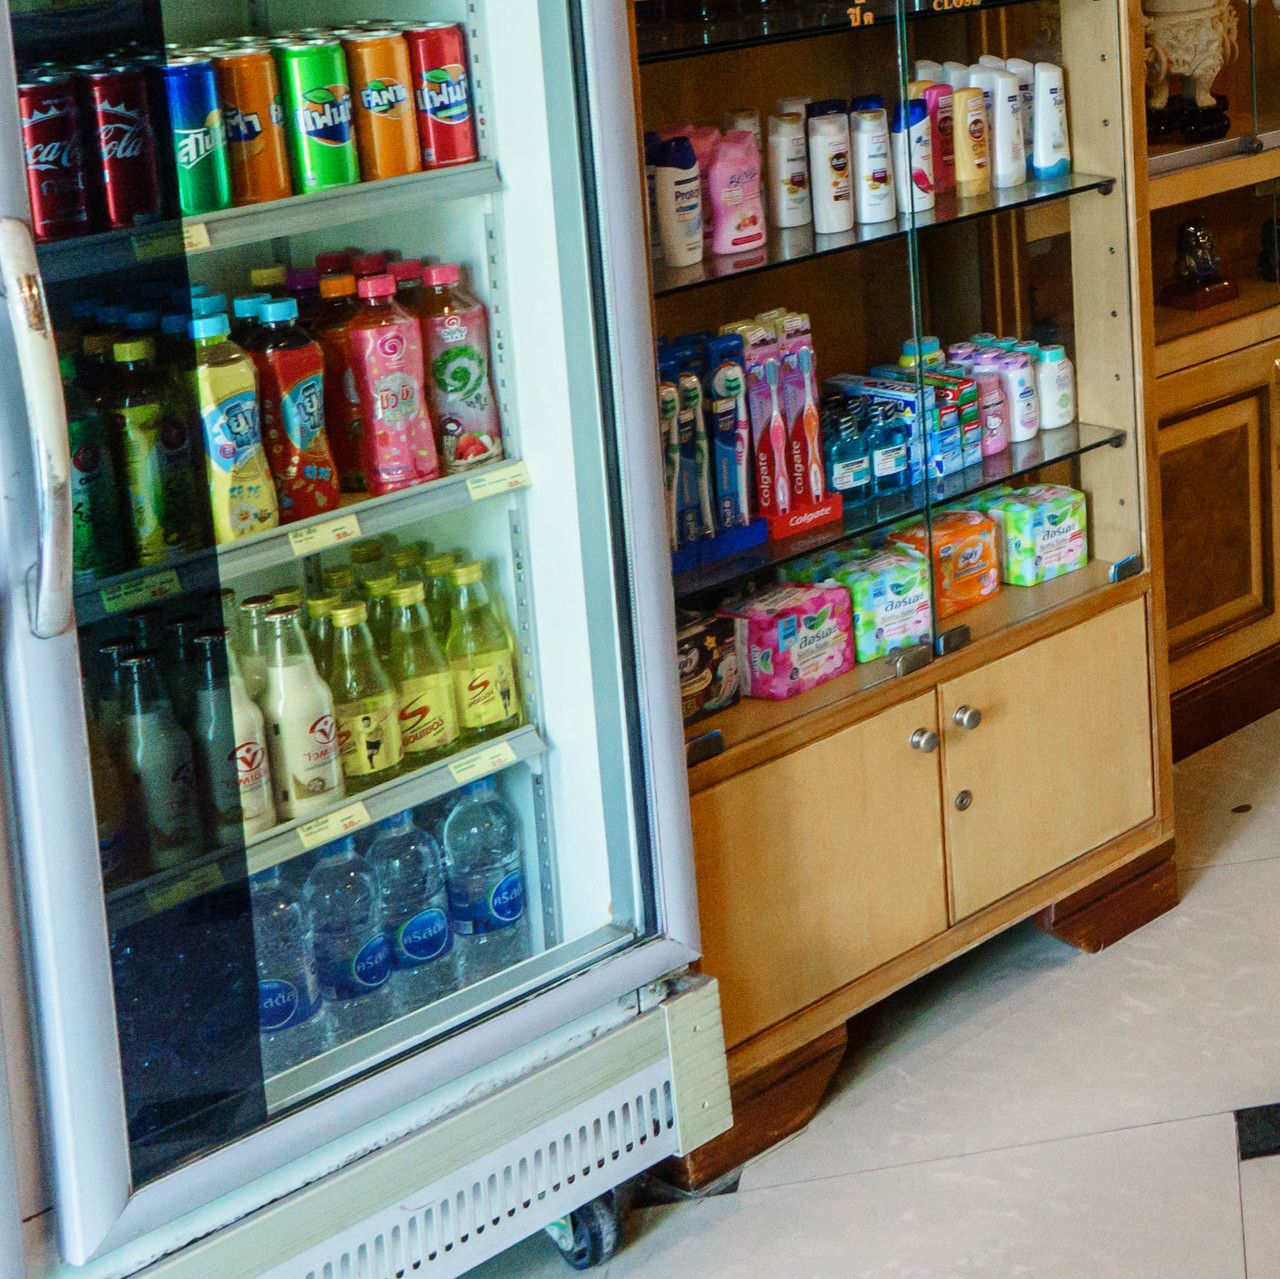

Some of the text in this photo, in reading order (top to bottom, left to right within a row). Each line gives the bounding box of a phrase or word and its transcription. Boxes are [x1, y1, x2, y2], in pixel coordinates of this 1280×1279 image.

[759, 452, 772, 507] Colgate
[792, 440, 804, 495] Colgate
[789, 505, 833, 527] Colgate
